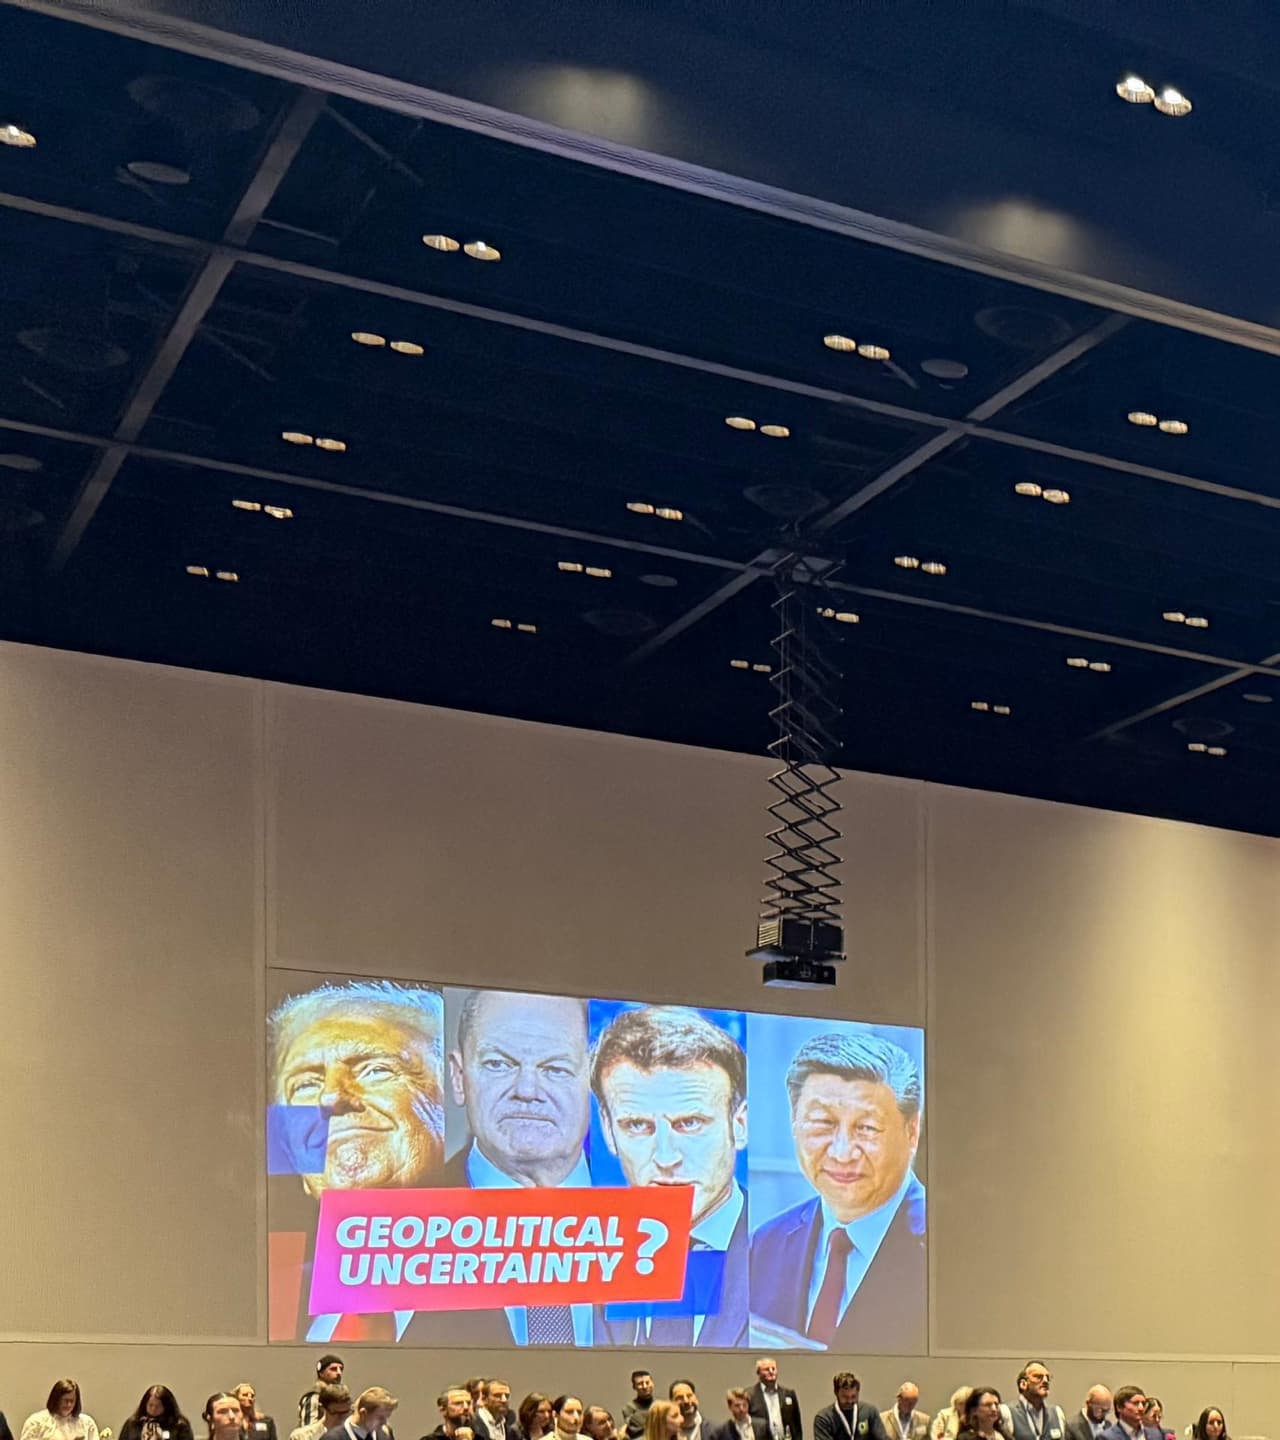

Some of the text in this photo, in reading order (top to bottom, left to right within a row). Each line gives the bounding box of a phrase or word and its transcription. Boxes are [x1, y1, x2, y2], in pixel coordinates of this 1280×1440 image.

[336, 1216, 623, 1248] GEOPOLITICAL
[635, 1218, 669, 1275] ?
[338, 1252, 624, 1285] UNCERTAINTY
